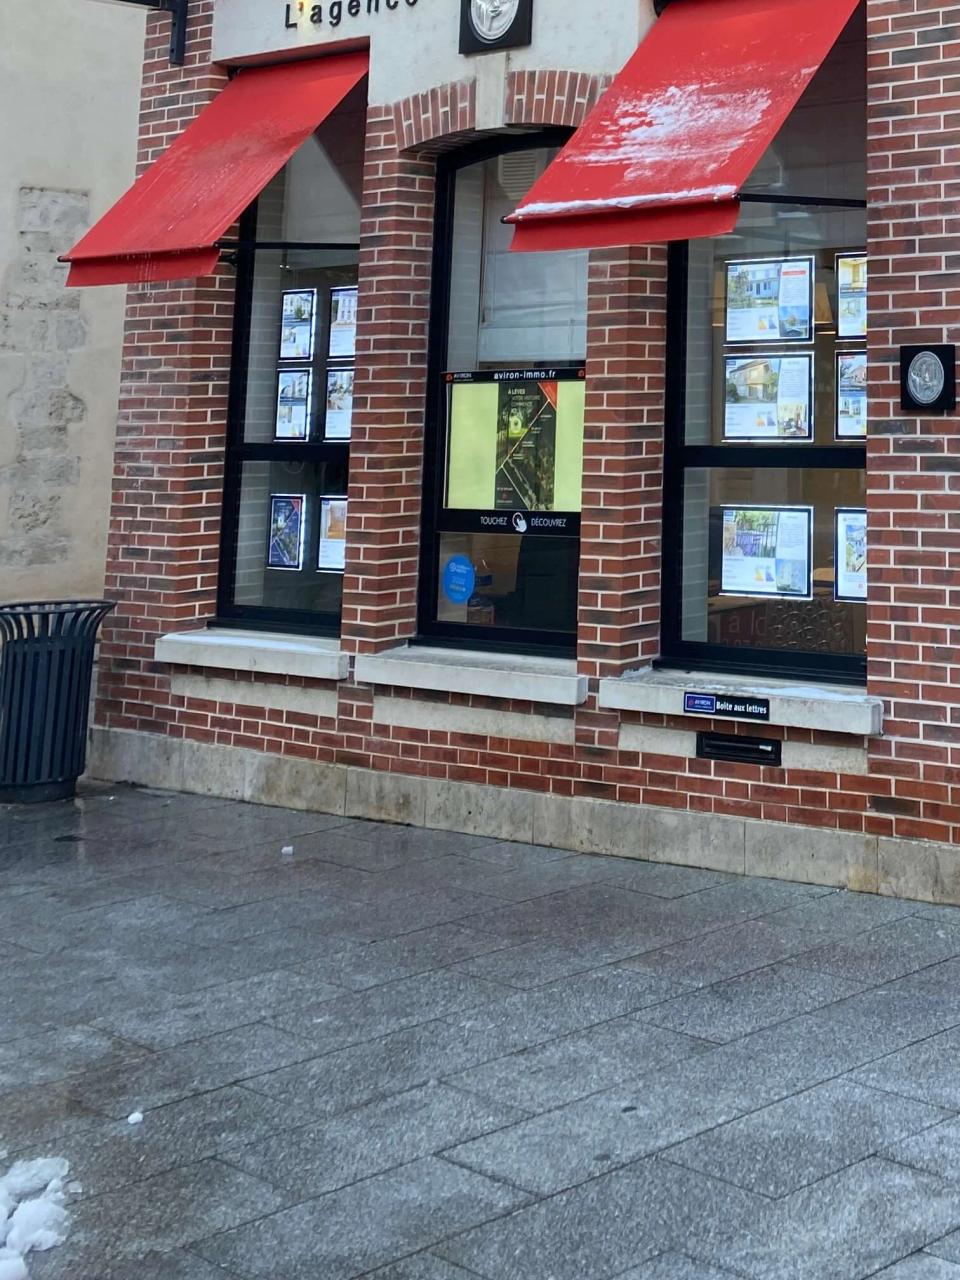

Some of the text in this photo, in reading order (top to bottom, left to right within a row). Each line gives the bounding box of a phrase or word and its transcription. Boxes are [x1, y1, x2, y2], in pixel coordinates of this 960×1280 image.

[493, 370, 556, 380] aviron-immo.fr
[480, 515, 508, 526] TOUCHEZ
[733, 704, 746, 712] aux
[746, 704, 767, 714] lettres
